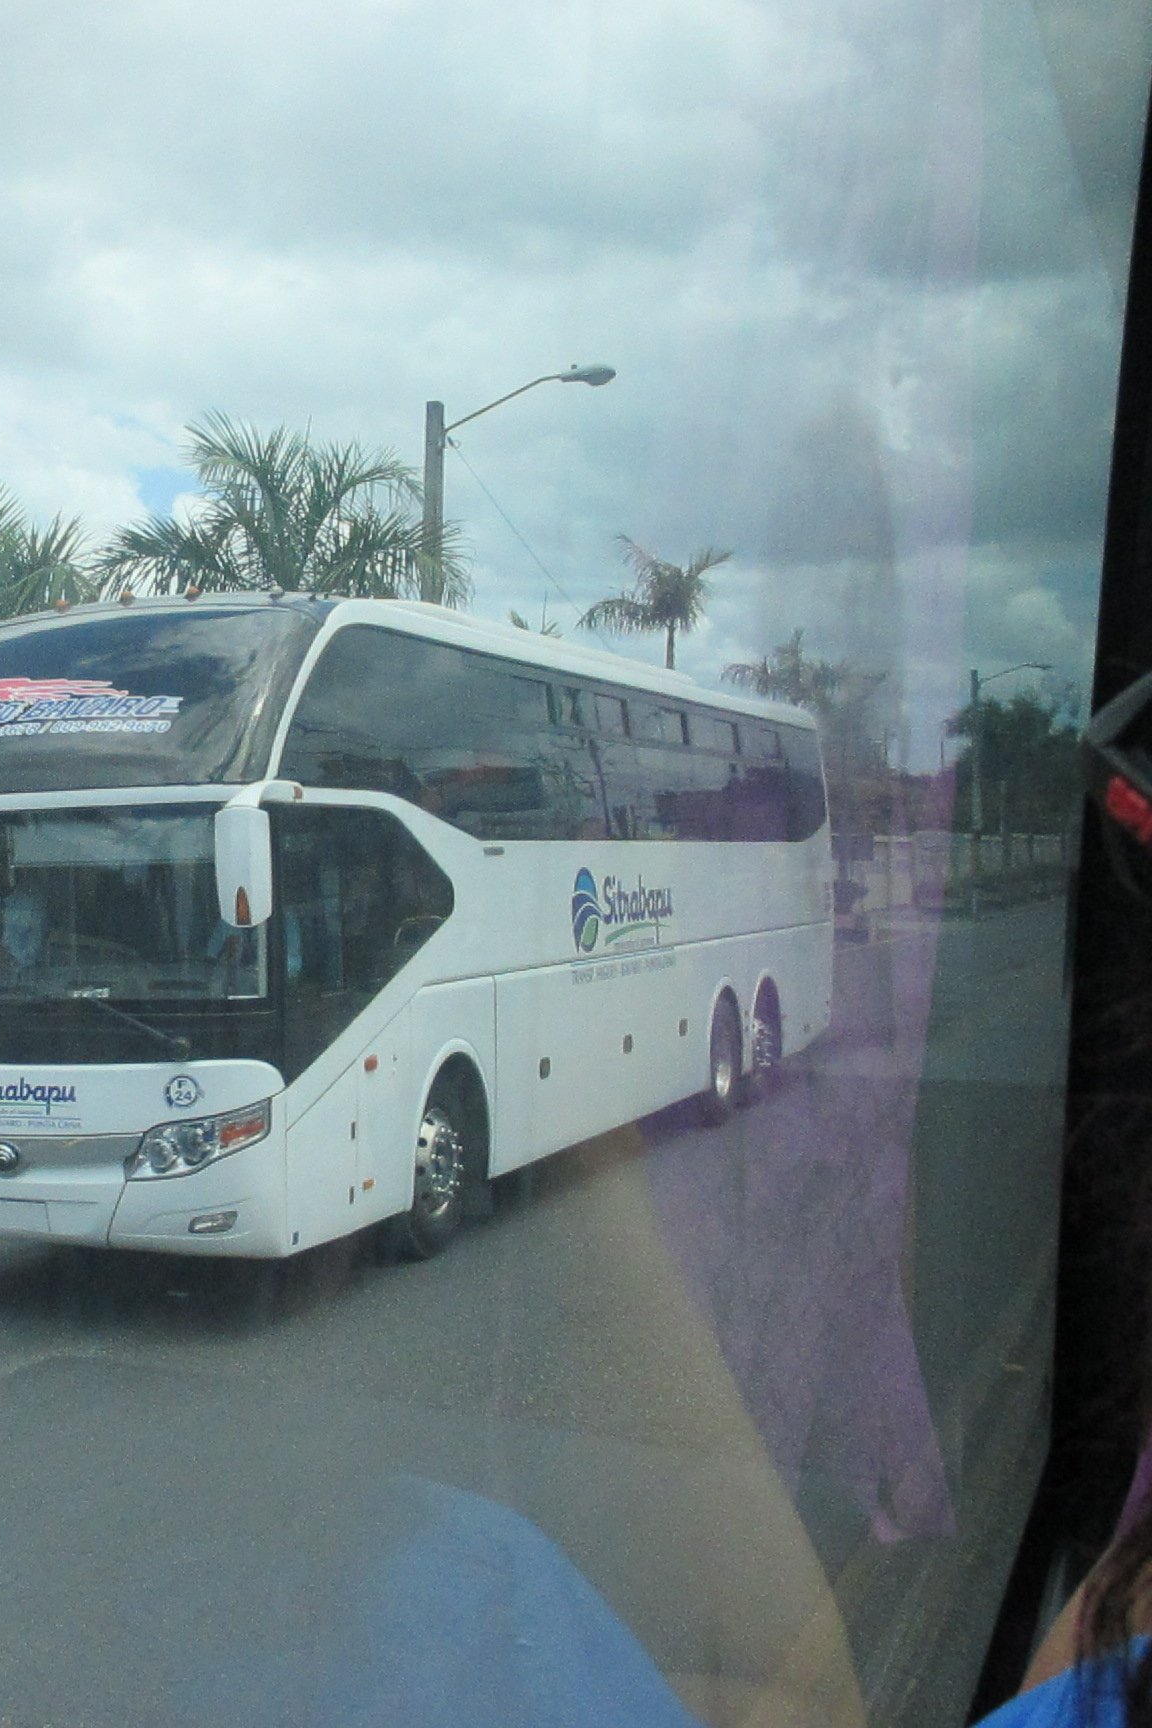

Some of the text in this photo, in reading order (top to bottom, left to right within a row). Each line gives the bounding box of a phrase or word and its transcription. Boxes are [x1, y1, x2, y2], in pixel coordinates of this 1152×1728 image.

[16, 696, 169, 721] BAVARO
[603, 873, 673, 945] Sitrabapu
[174, 1090, 193, 1101] 24
